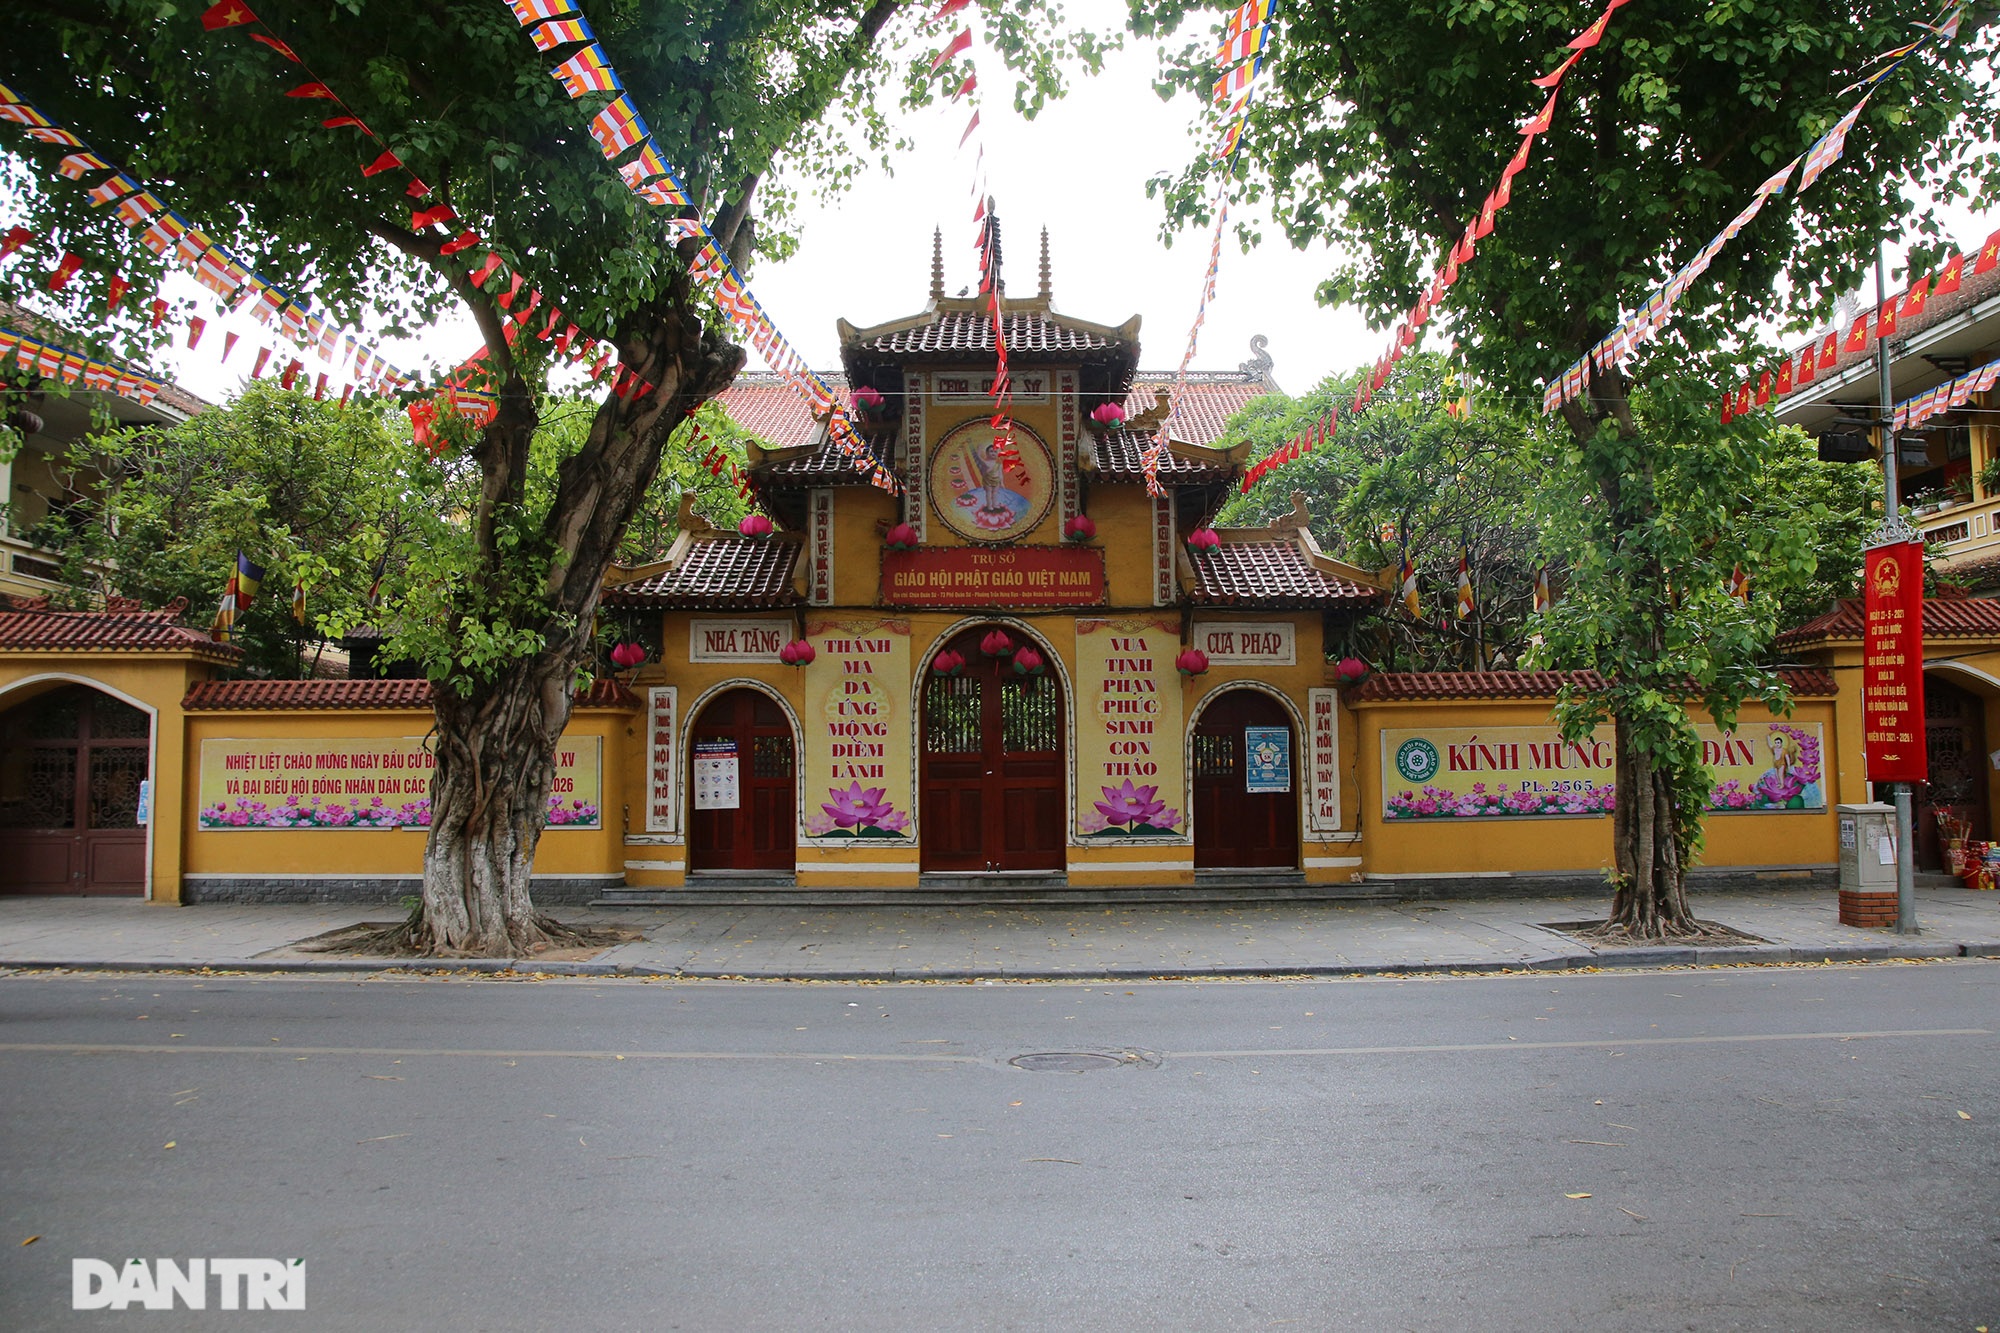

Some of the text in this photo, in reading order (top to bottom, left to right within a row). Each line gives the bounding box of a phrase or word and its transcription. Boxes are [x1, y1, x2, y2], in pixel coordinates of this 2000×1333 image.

[971, 552, 1016, 566] TRỤ SỞ
[894, 568, 1091, 588] GIÁO HỘI PHẬT GIÁO VIỆT NAM
[704, 628, 780, 652] NHÀ TĂNG
[824, 636, 890, 653] THÁNH
[1241, 632, 1281, 654] PHÁP
[843, 660, 873, 674] MA
[845, 681, 871, 694] DA
[838, 698, 877, 715] ỨNG
[1103, 638, 1157, 776] VUA TỊNH PHẠN PHÚC SINH CON THẢO
[828, 720, 887, 739] MỘNG
[655, 748, 669, 765] HỘI
[1448, 730, 1757, 771] KÍNH MỪNG ĐẢN
[226, 752, 256, 773] NHIỆT
[260, 752, 281, 773] LIỆT
[284, 752, 312, 769] CHÀO
[316, 751, 347, 769] MỪNG
[351, 751, 379, 769] NGÀY
[383, 748, 404, 768] BẦU
[408, 748, 423, 768] CỬ
[561, 752, 575, 767] XV
[832, 760, 884, 778] LÀNH
[226, 776, 240, 794] VÀ
[243, 780, 260, 798] ĐẠI
[264, 774, 288, 794] BIỂU
[292, 776, 309, 798] HỘI
[312, 774, 341, 794] ĐỒNG
[345, 776, 374, 794] NHÂN
[378, 776, 400, 794] DÂN
[404, 776, 425, 794] CÁC
